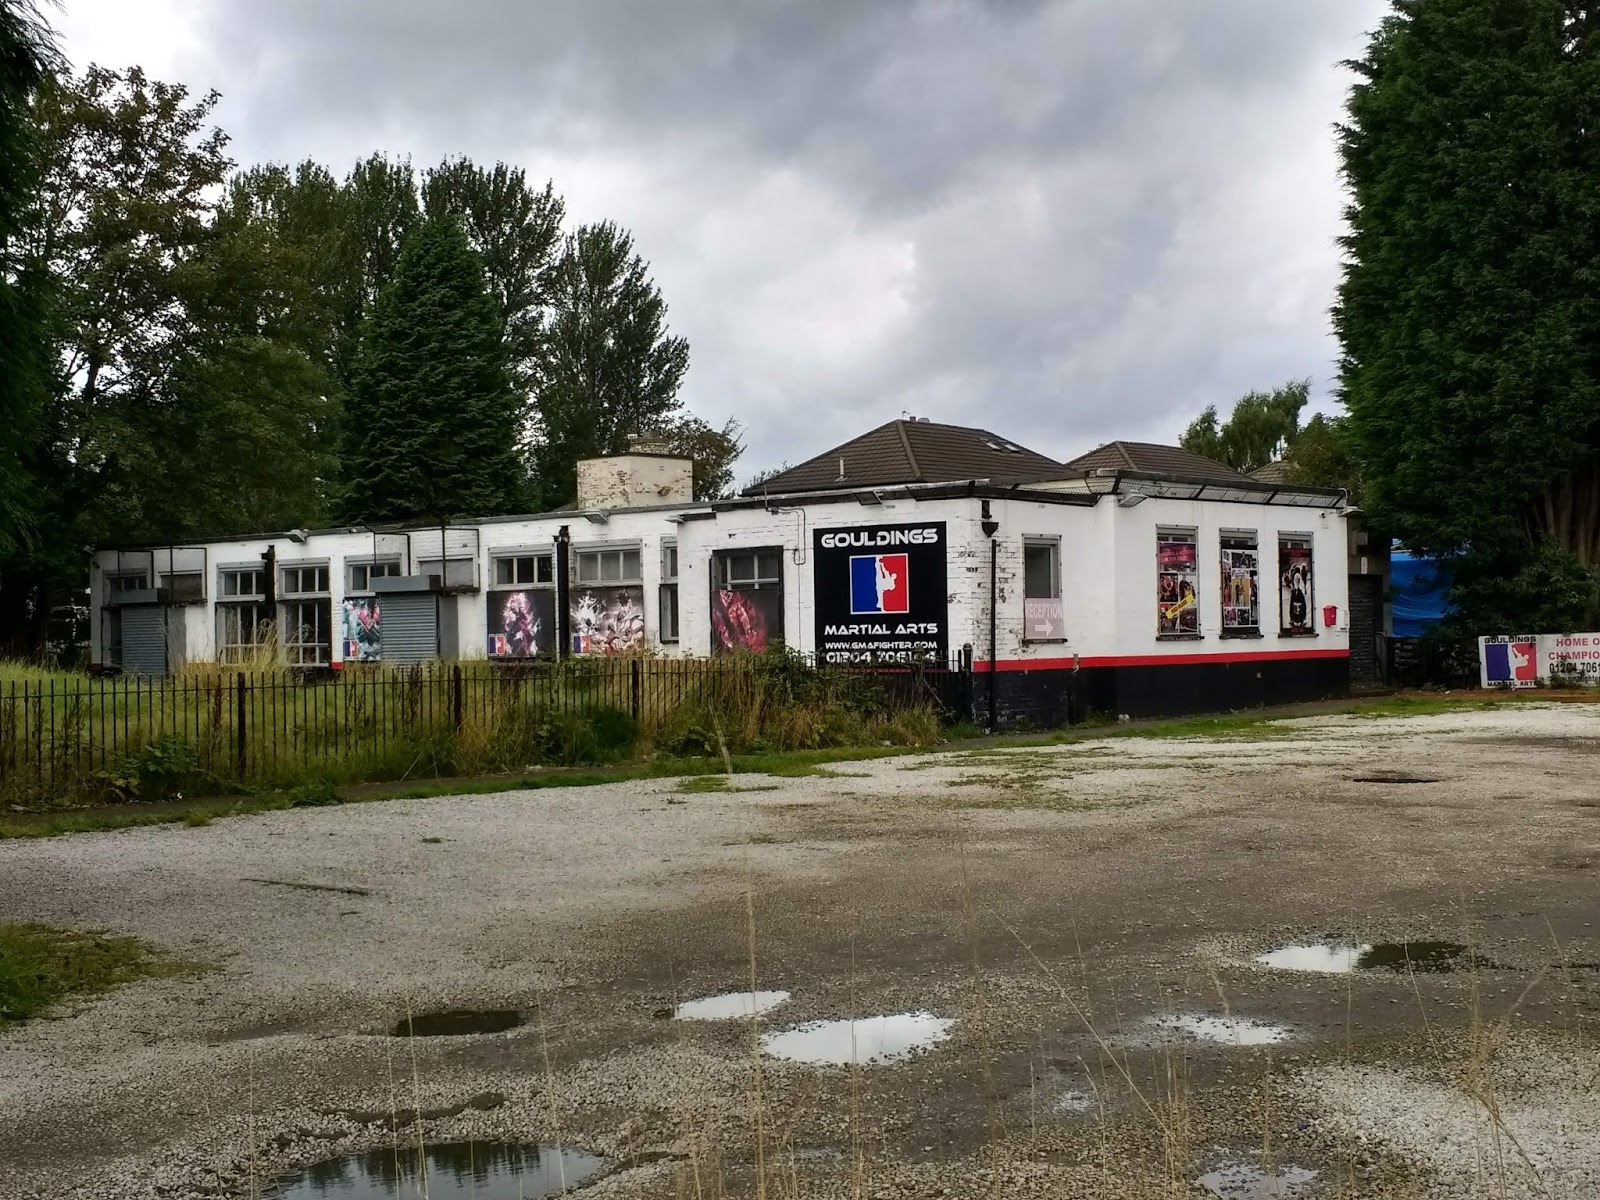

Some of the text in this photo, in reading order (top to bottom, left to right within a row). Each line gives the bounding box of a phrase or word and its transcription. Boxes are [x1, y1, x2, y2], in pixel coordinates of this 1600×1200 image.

[821, 528, 938, 548] GOULDINGS
[1025, 603, 1063, 618] RECEPTION
[824, 623, 938, 635] MARTIAL ARTS
[825, 641, 938, 649] WWW.GMAFIGHTER.COM
[1556, 638, 1589, 646] HOME
[1548, 651, 1600, 660] CHAMPIO
